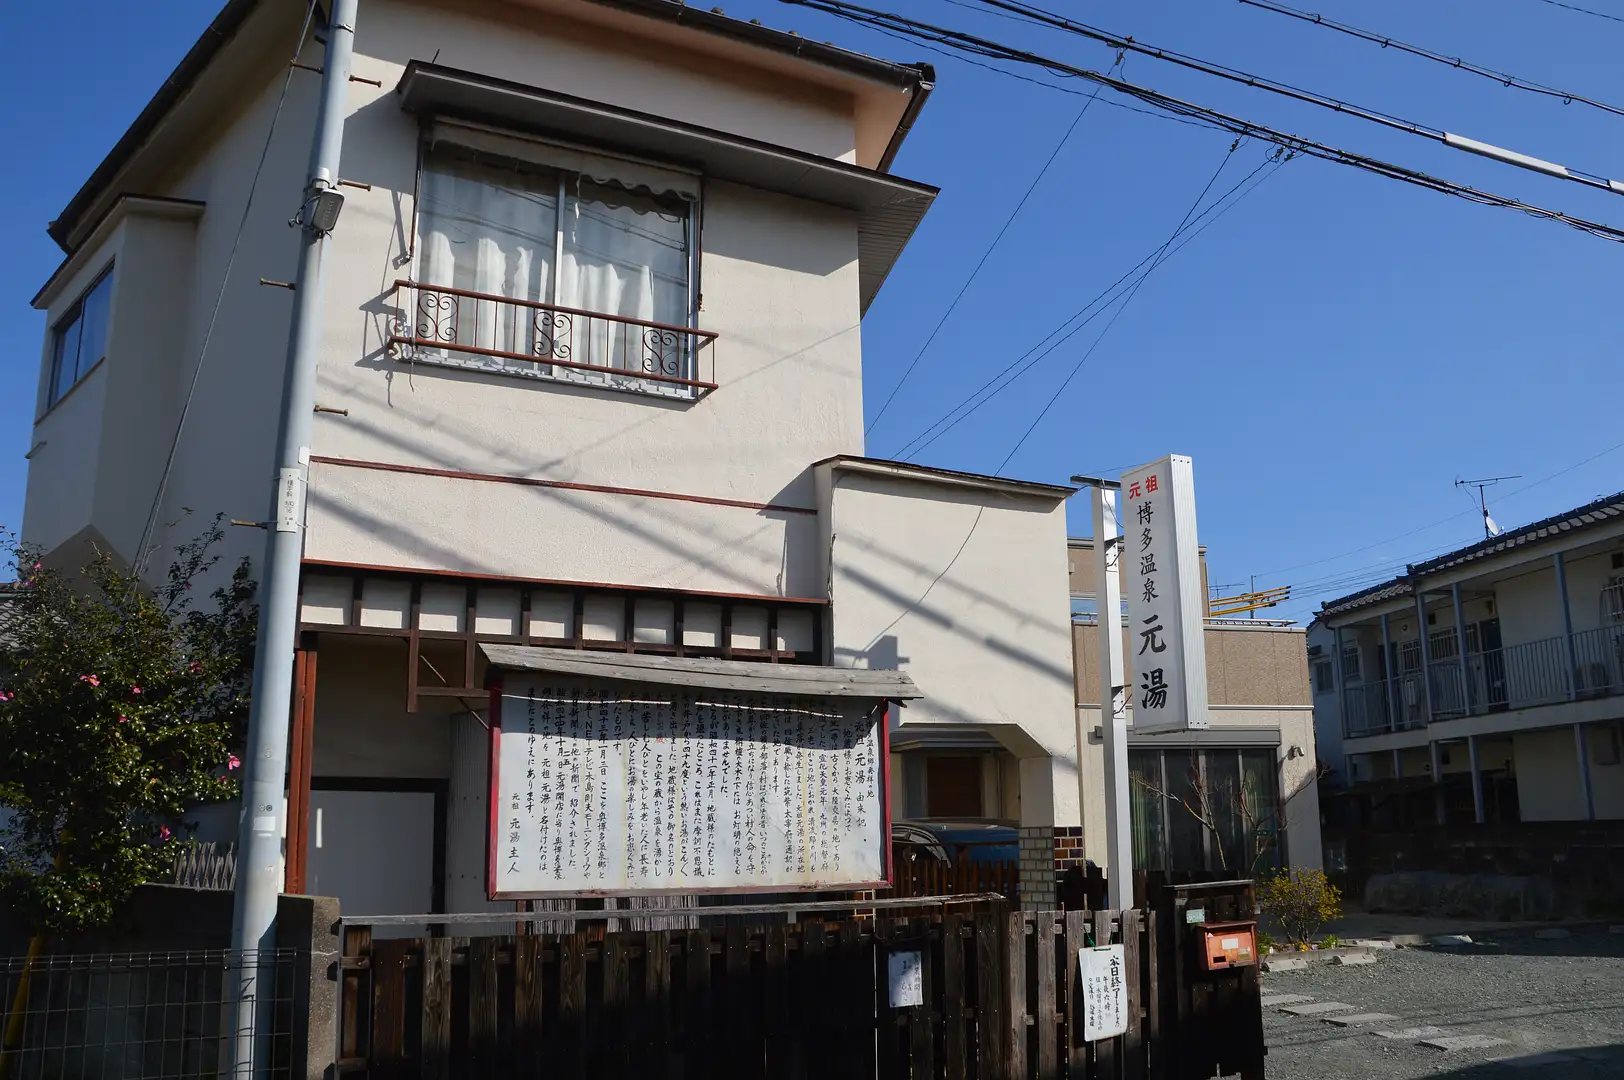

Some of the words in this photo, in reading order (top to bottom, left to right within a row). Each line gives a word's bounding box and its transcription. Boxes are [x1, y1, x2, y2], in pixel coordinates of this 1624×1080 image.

[1128, 475, 1159, 500] 元祖
[1137, 501, 1159, 603] 博多温泉
[1138, 614, 1168, 710] 元湯
[854, 720, 864, 745] 元祖
[854, 753, 866, 784] 元湯
[511, 793, 521, 810] 元祖
[855, 792, 866, 828] 由来記
